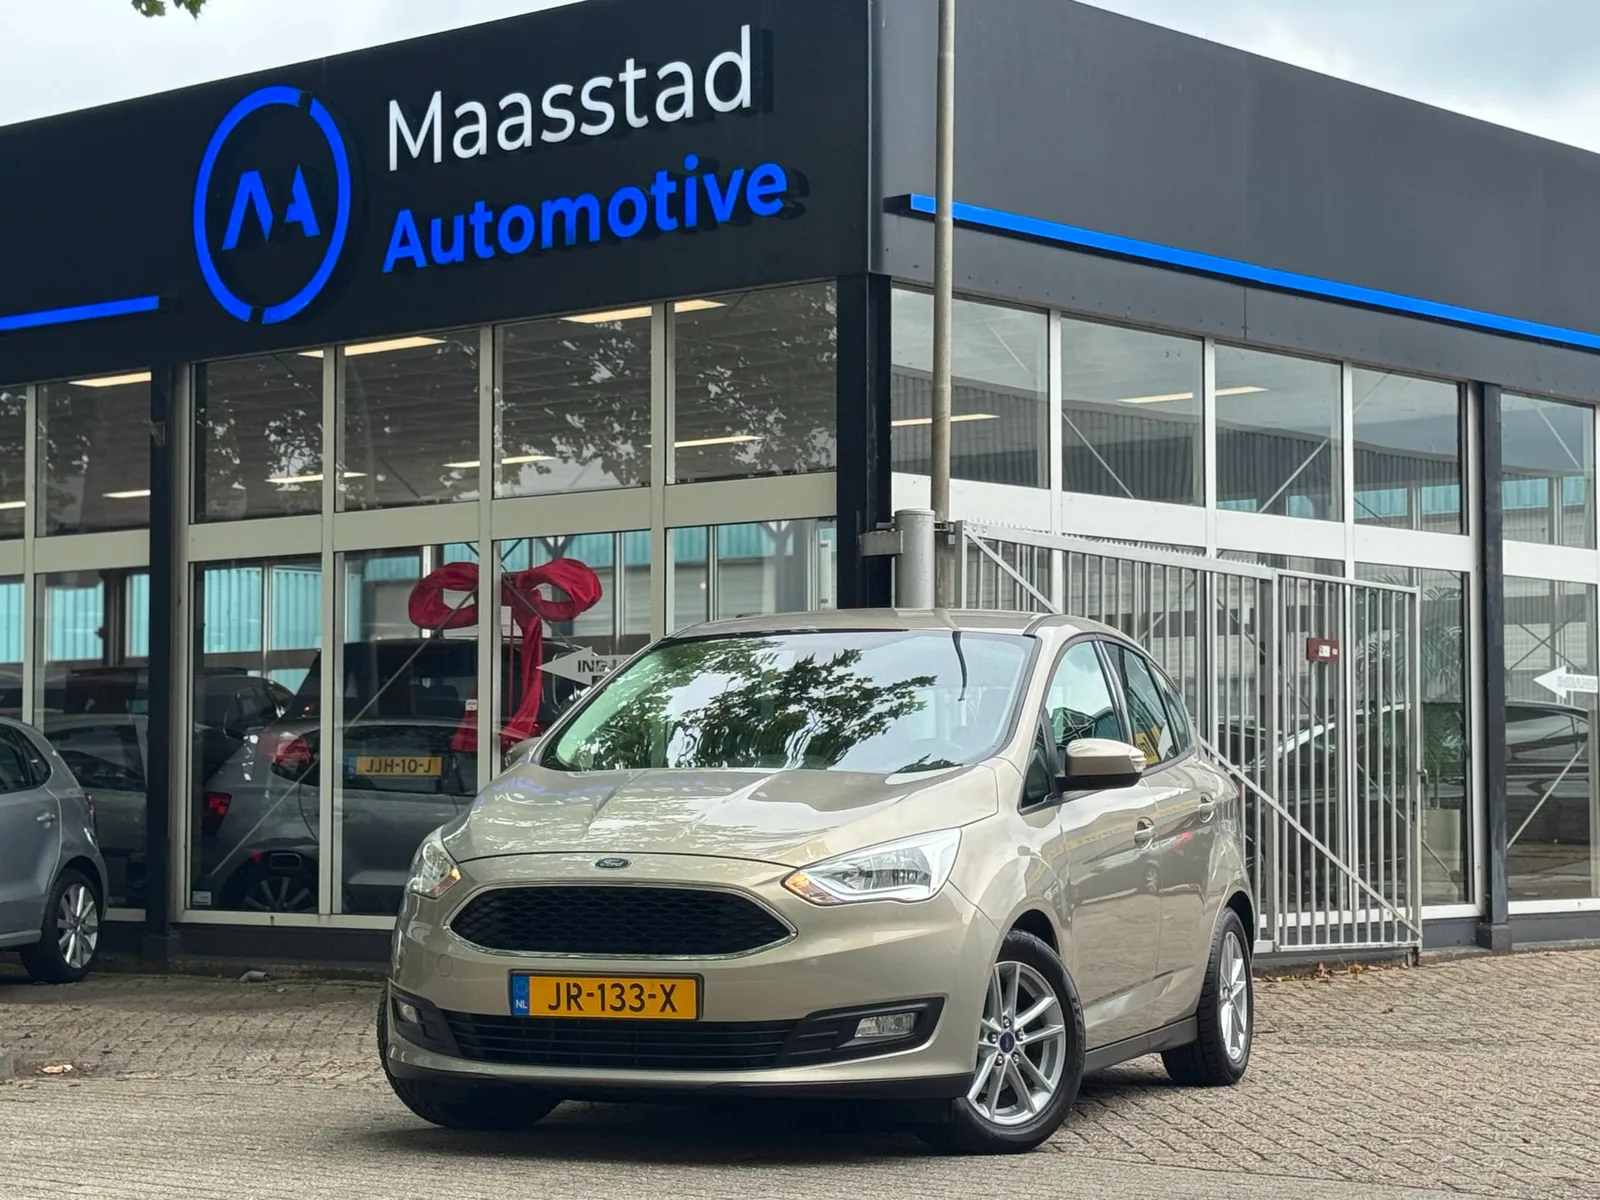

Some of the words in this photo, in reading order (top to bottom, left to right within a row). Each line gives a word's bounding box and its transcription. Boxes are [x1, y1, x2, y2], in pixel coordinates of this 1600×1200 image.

[388, 24, 753, 171] Maasstad
[381, 153, 789, 273] Automotive
[365, 758, 432, 774] JJH-10-J
[515, 999, 528, 1009] NL
[547, 981, 678, 1013] JR-133-X
